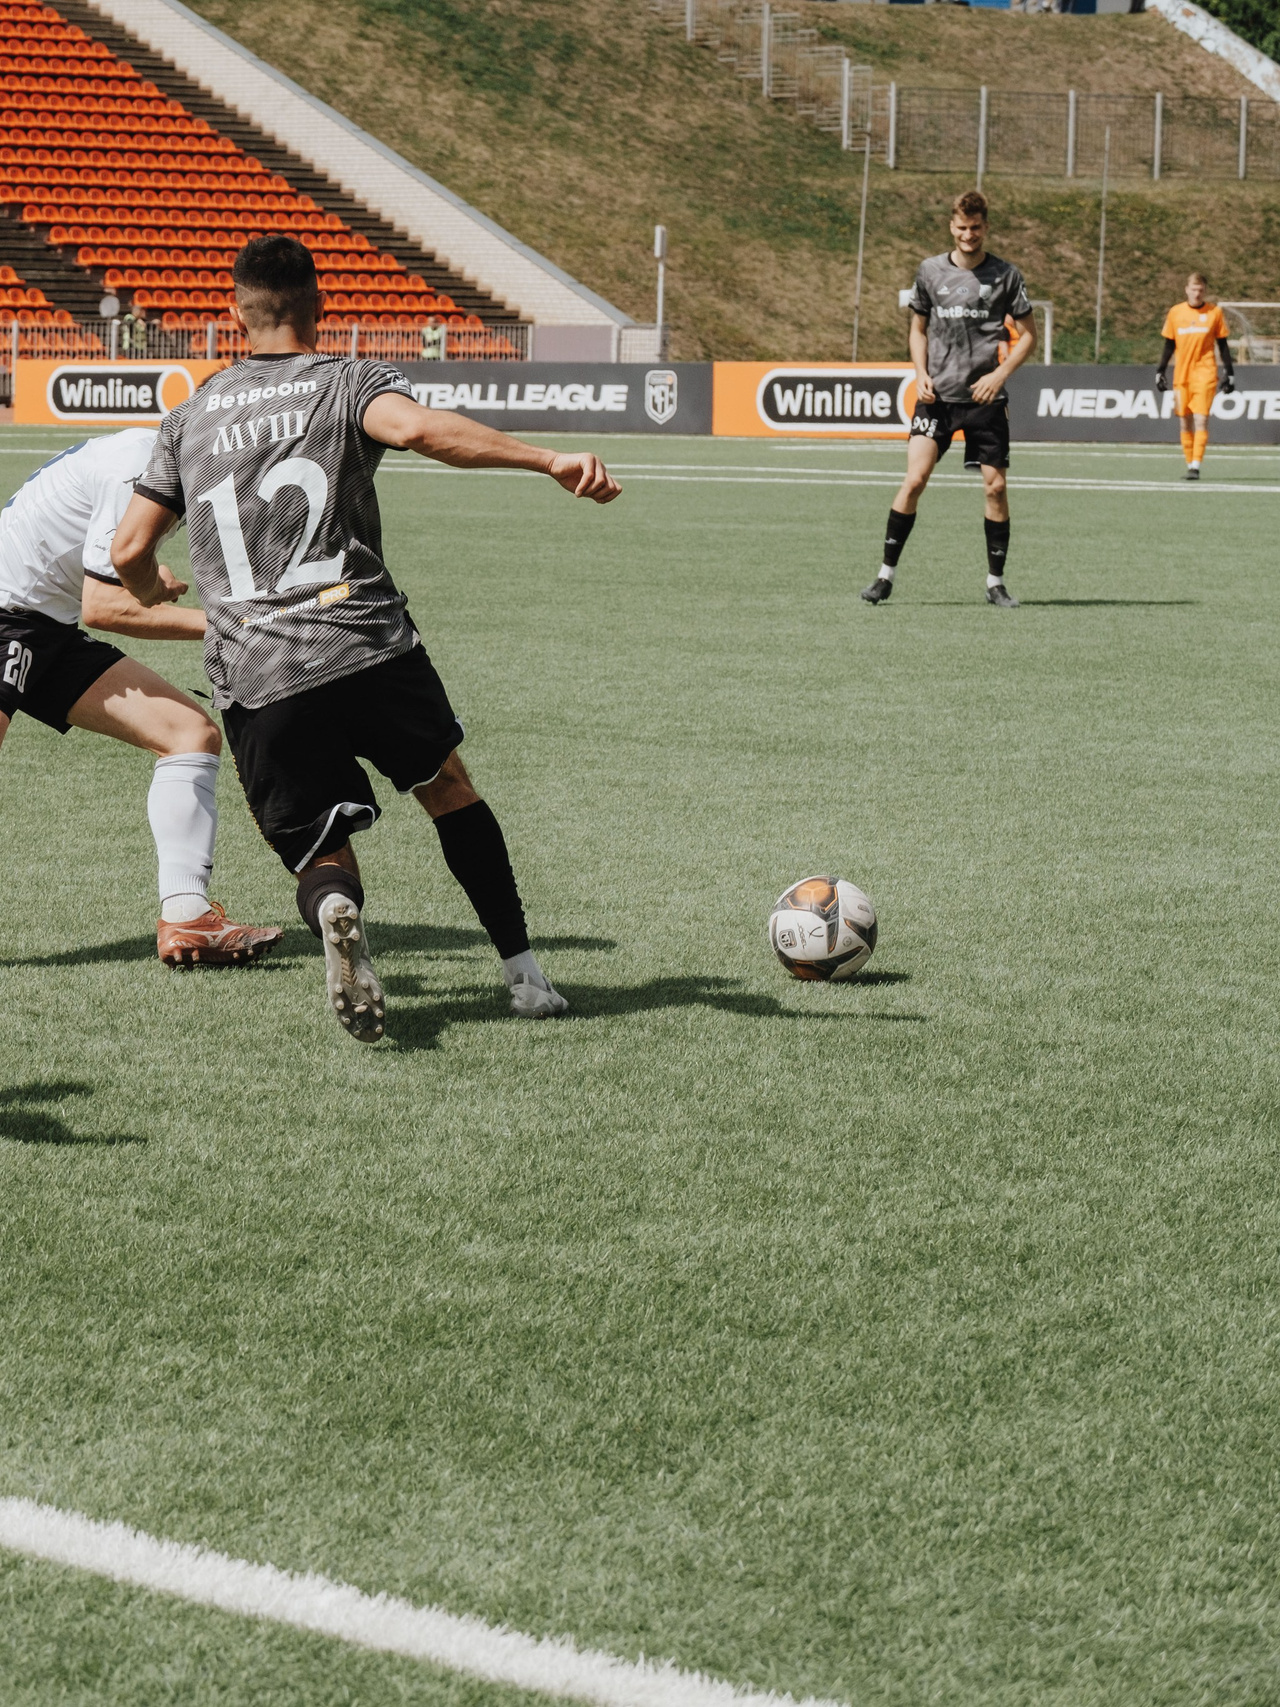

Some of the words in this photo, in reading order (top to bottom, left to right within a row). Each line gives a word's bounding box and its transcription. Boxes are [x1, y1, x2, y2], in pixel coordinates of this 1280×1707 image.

[59, 378, 153, 409] Winline
[205, 380, 317, 412] BetBoom
[506, 383, 629, 412] LEAGUE
[773, 383, 891, 418] Winline
[1036, 388, 1162, 421] MEDIA
[197, 457, 345, 603] 12
[321, 586, 347, 603] PRO
[2, 639, 33, 693] 20
